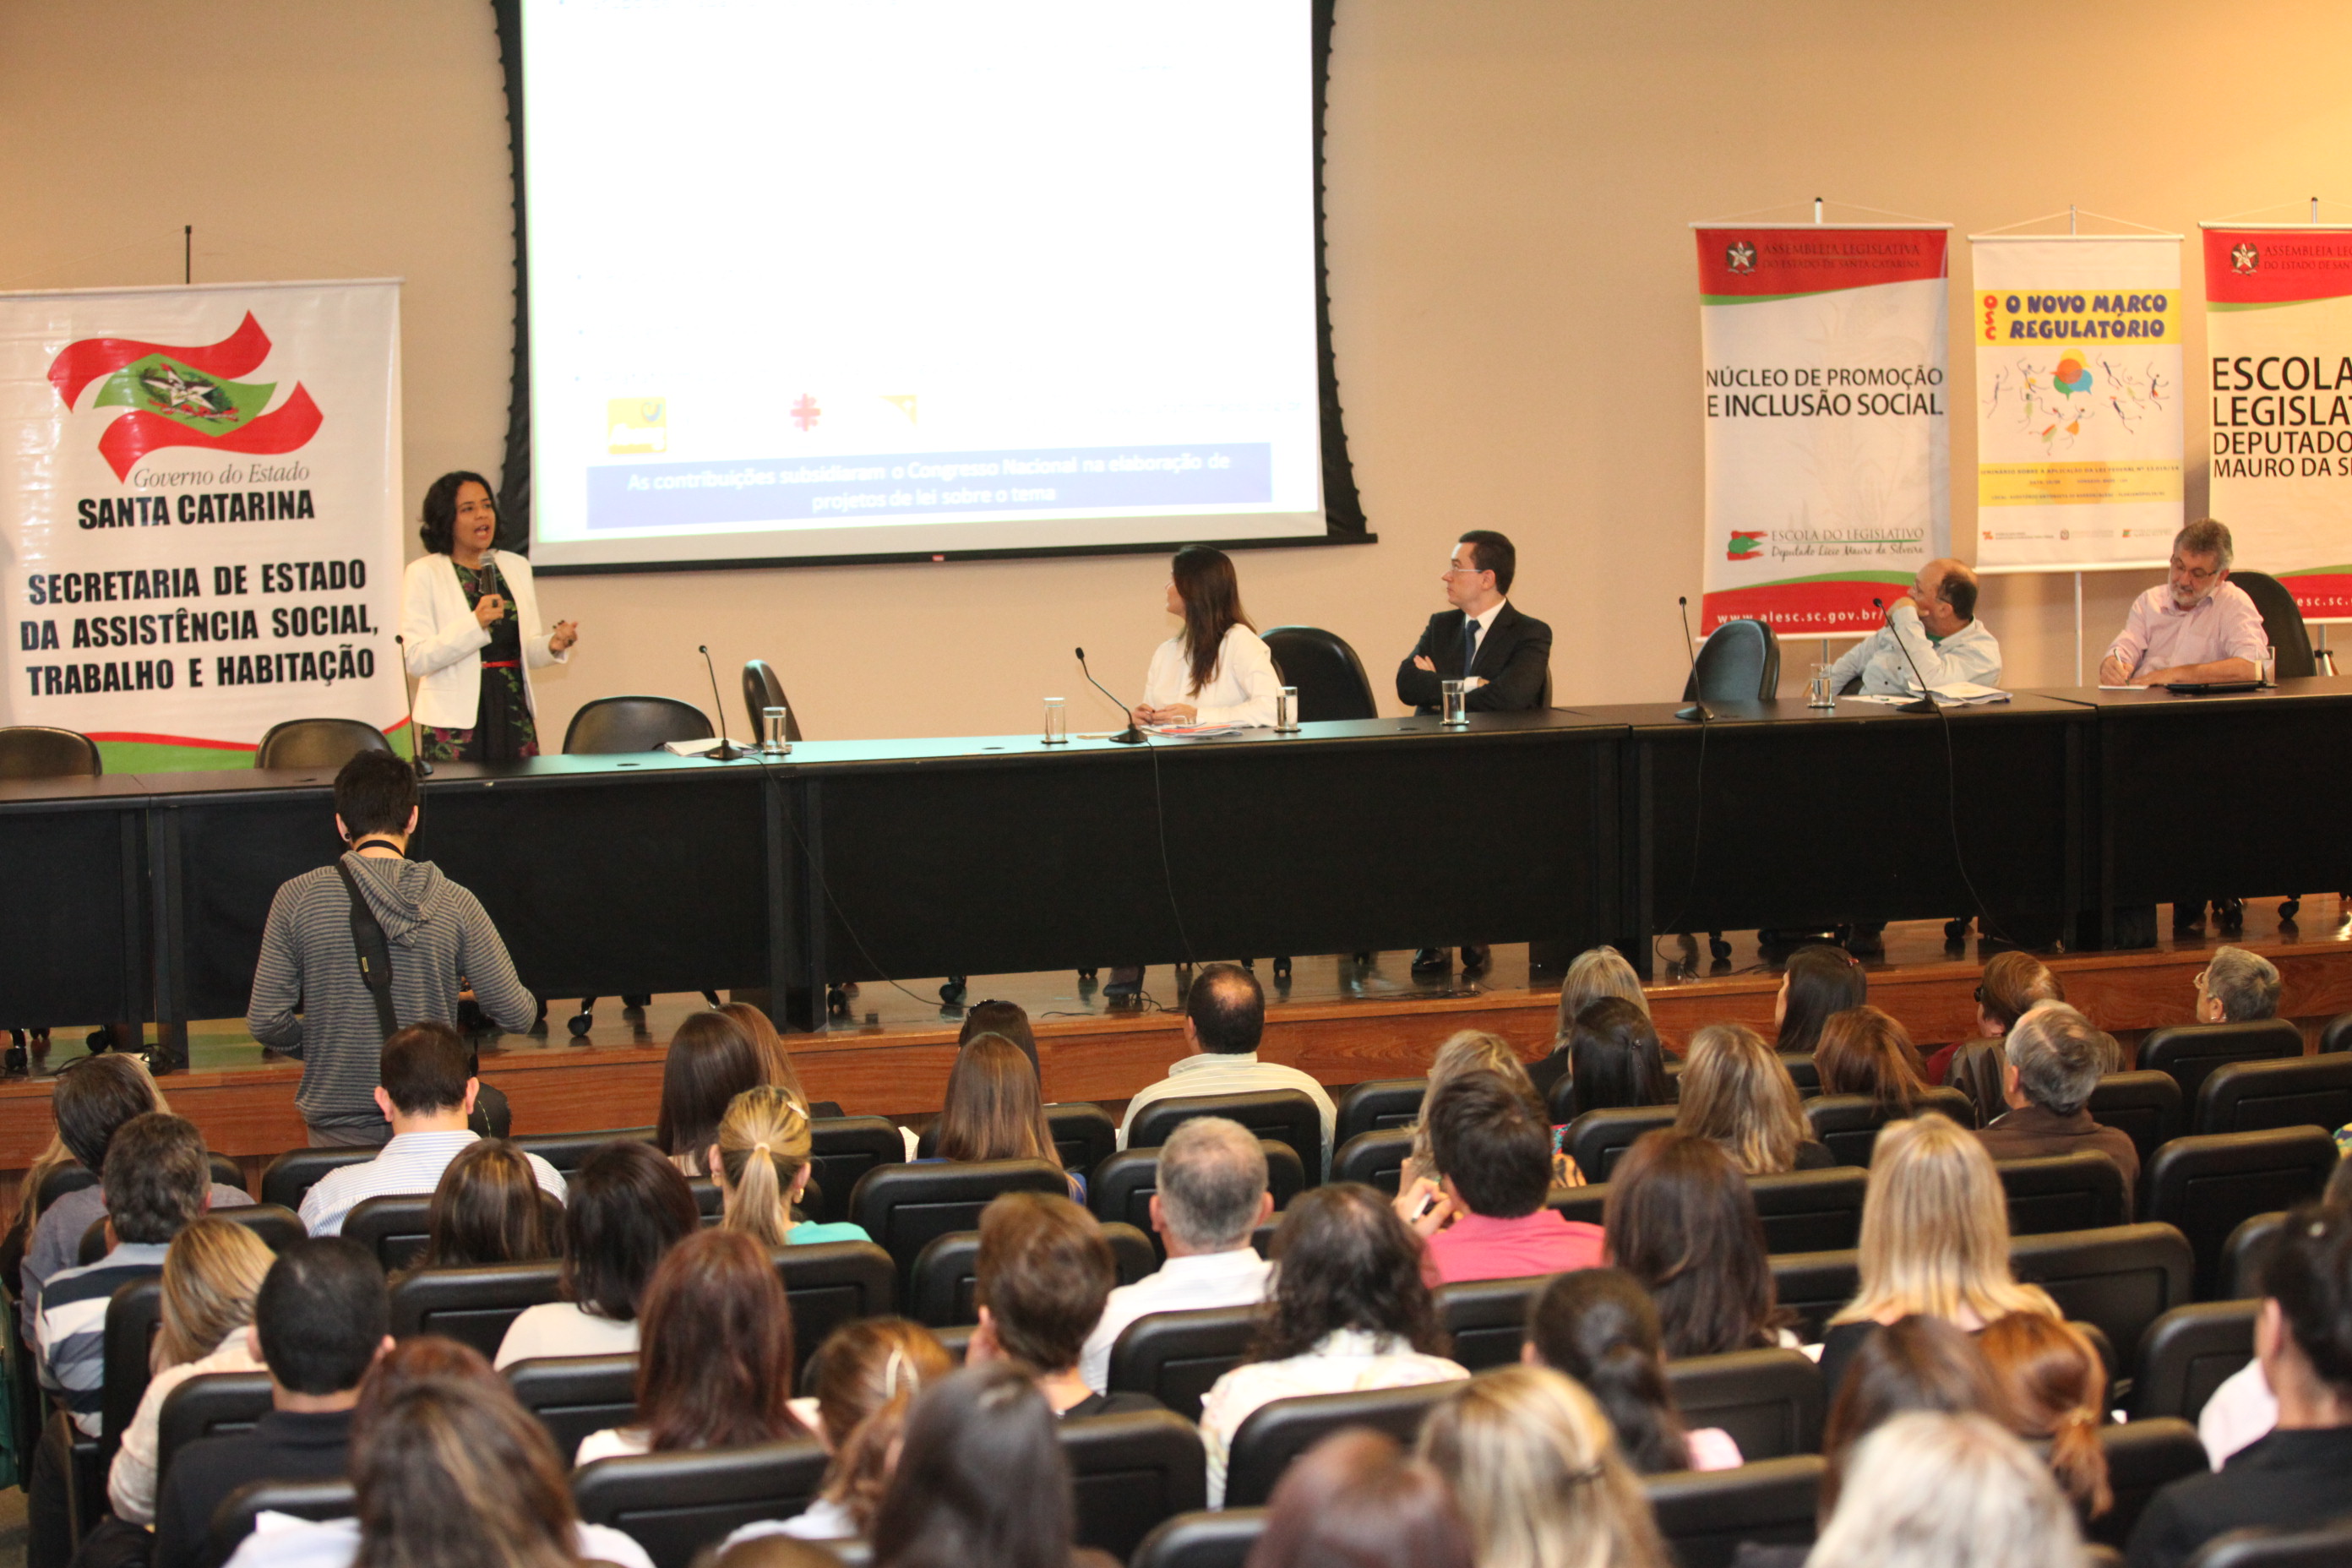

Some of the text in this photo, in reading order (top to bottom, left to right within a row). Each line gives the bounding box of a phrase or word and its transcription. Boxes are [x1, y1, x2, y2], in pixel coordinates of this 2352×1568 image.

[1763, 243, 1919, 255] ASSEMBLEIA LEGISLATIVA
[2265, 245, 2333, 256] ASSEMBLEIA
[2264, 260, 2279, 270] DO
[2282, 260, 2316, 270] ESTADO
[2006, 294, 2167, 313] O NOVO MARCO
[2009, 313, 2165, 339] REGULATÓRIO
[1706, 365, 1943, 391] NÚCLEO DE PROMOÇÃO
[2213, 357, 2352, 391] ESCOLA
[1707, 389, 1944, 416] E INCLUSÃO SOCIAL
[2213, 395, 2352, 427] LEGISLA
[2213, 430, 2352, 455] DEPUTADO
[133, 460, 310, 487] Governo do Estado
[627, 453, 1230, 491] As contribuições subsidiaram o Congresso Nacional na elaboração de
[2214, 457, 2295, 478] MAURO
[2301, 457, 2332, 476] DA
[78, 489, 315, 530] SANTA CATARINA
[811, 486, 1057, 514] projetos de lei sobre o tema
[1772, 528, 1925, 542] ESCOLA DO LEGISLATIVO
[28, 558, 366, 605] SECRETARIA DE ESTADO
[20, 604, 378, 651] DA ASSISTÊNCIA SOCIAL,
[25, 644, 374, 696] TRABALHO E HABITAÇÃO
